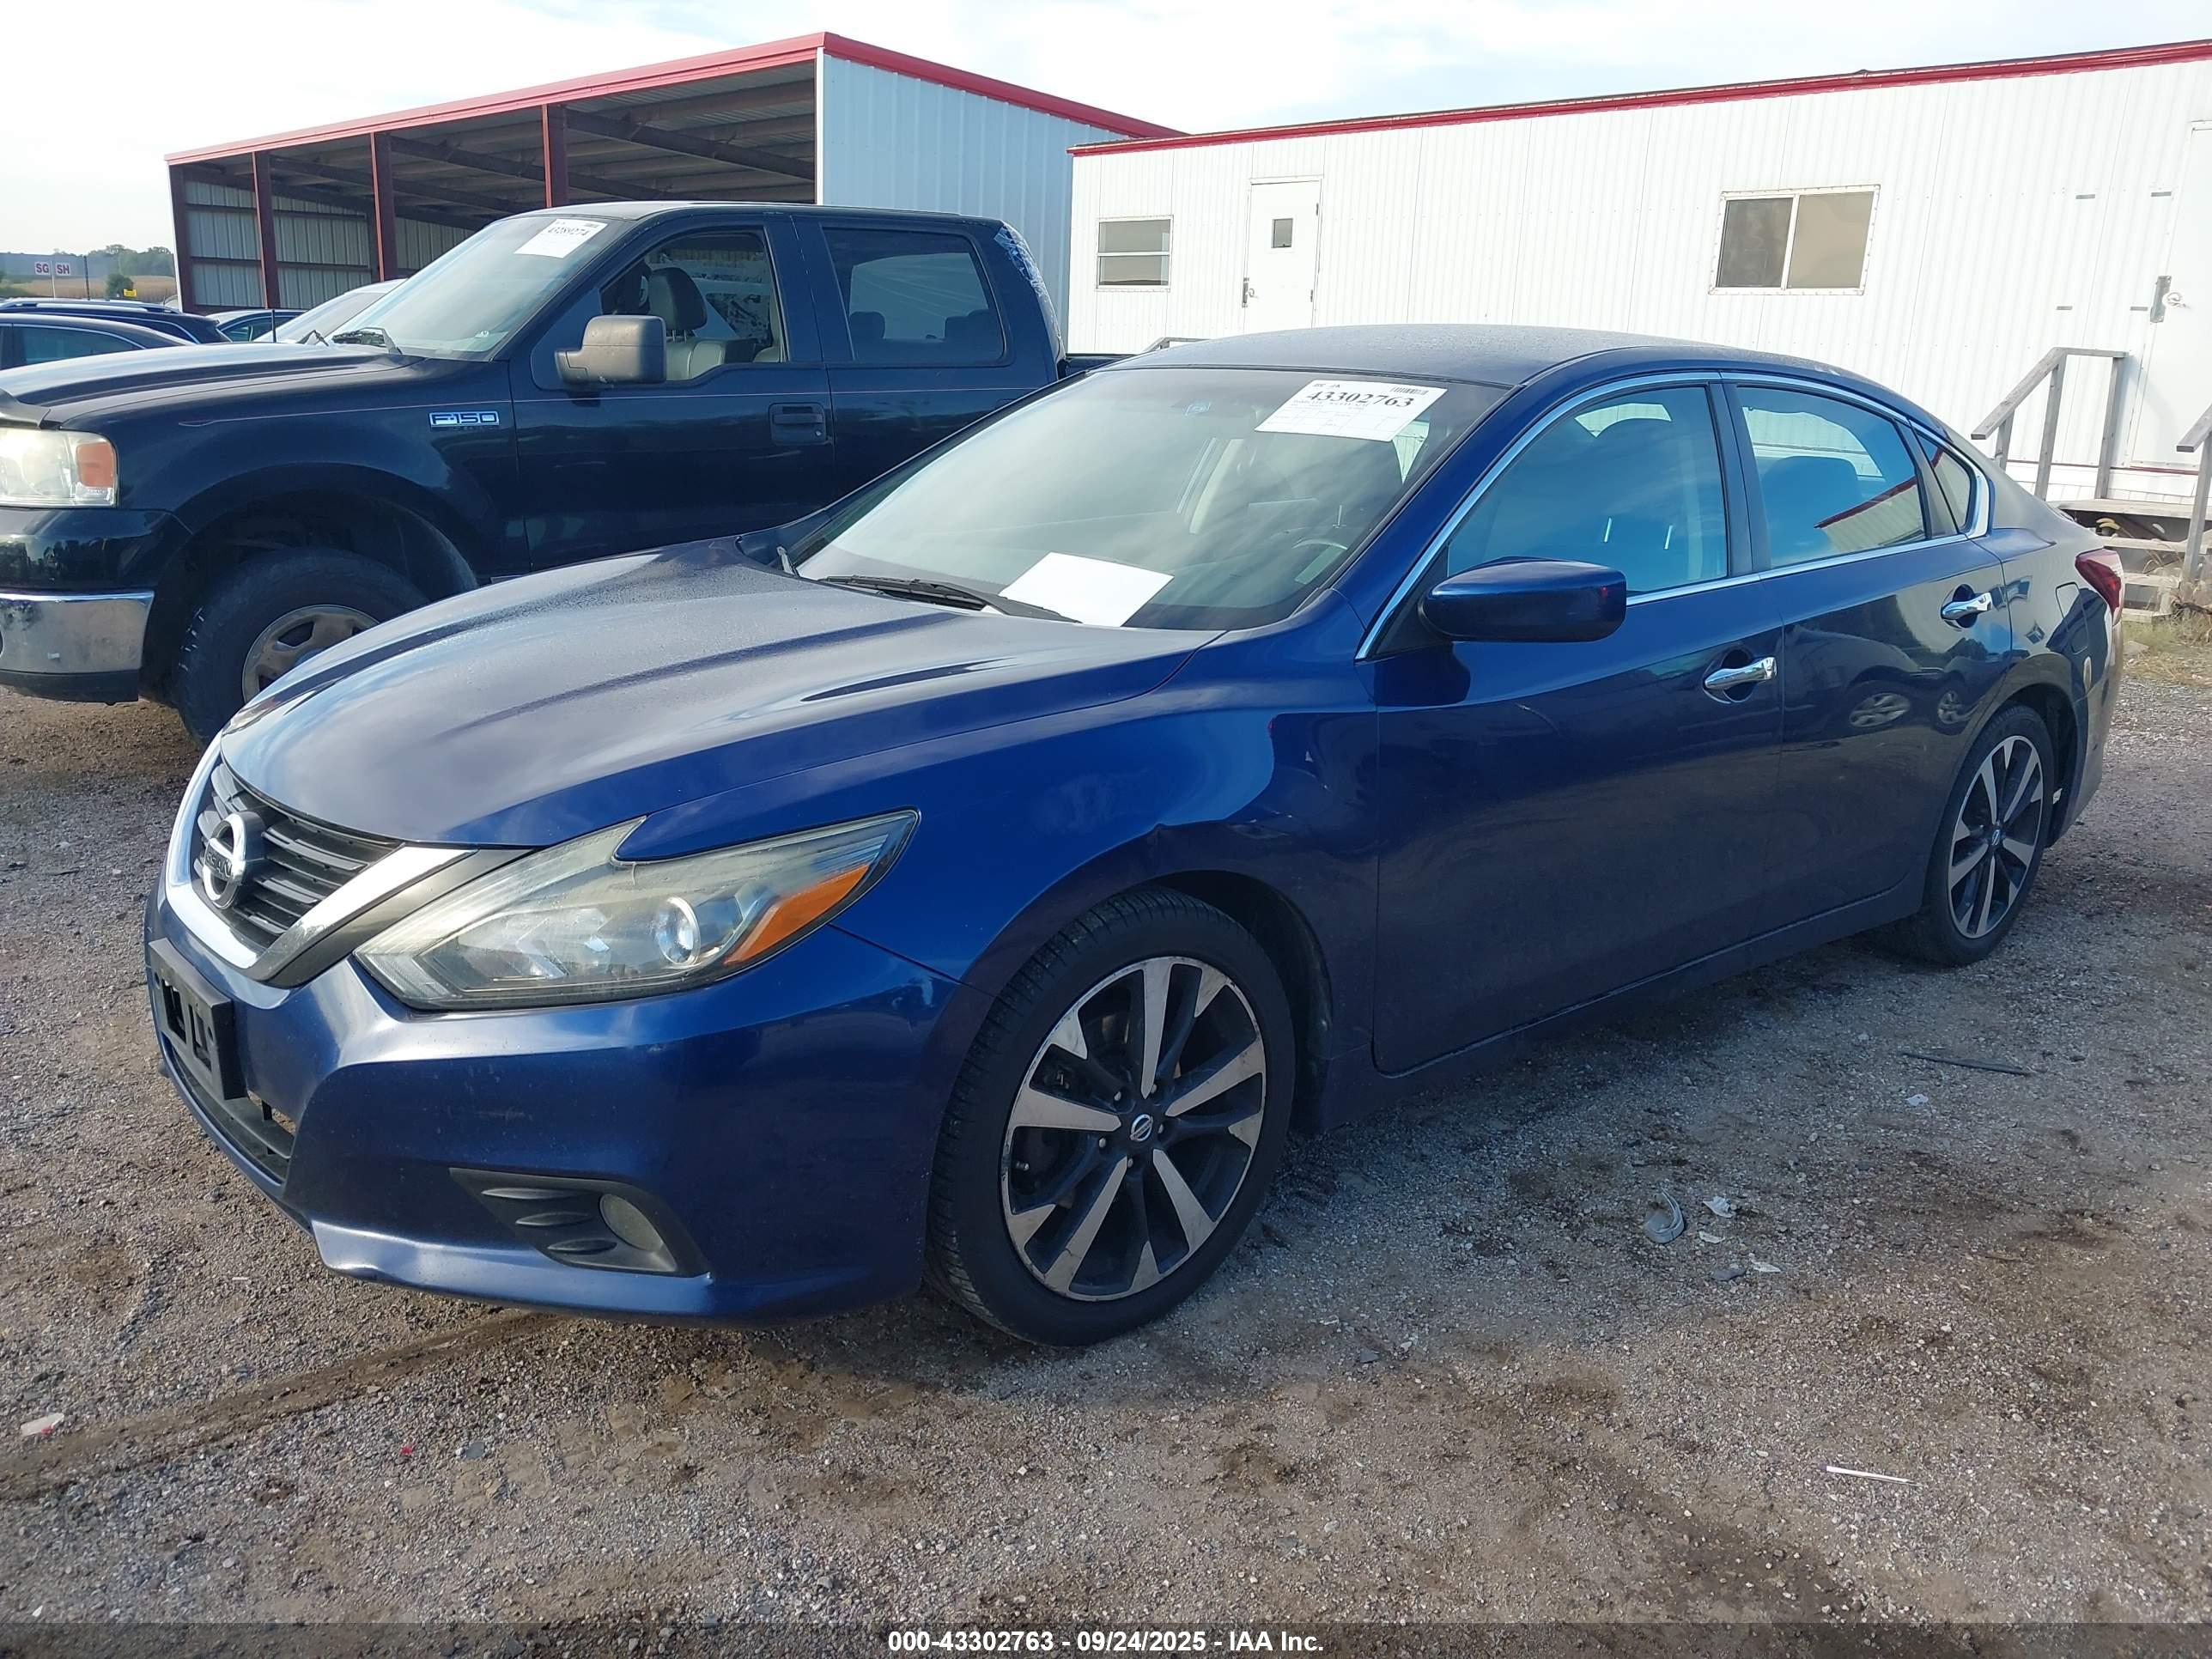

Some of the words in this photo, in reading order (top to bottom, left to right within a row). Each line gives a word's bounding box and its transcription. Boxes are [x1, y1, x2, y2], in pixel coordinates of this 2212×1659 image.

[36, 263, 50, 273] SG
[57, 264, 70, 274] SH
[1306, 391, 1415, 408] 43302763
[431, 412, 498, 425] F-150
